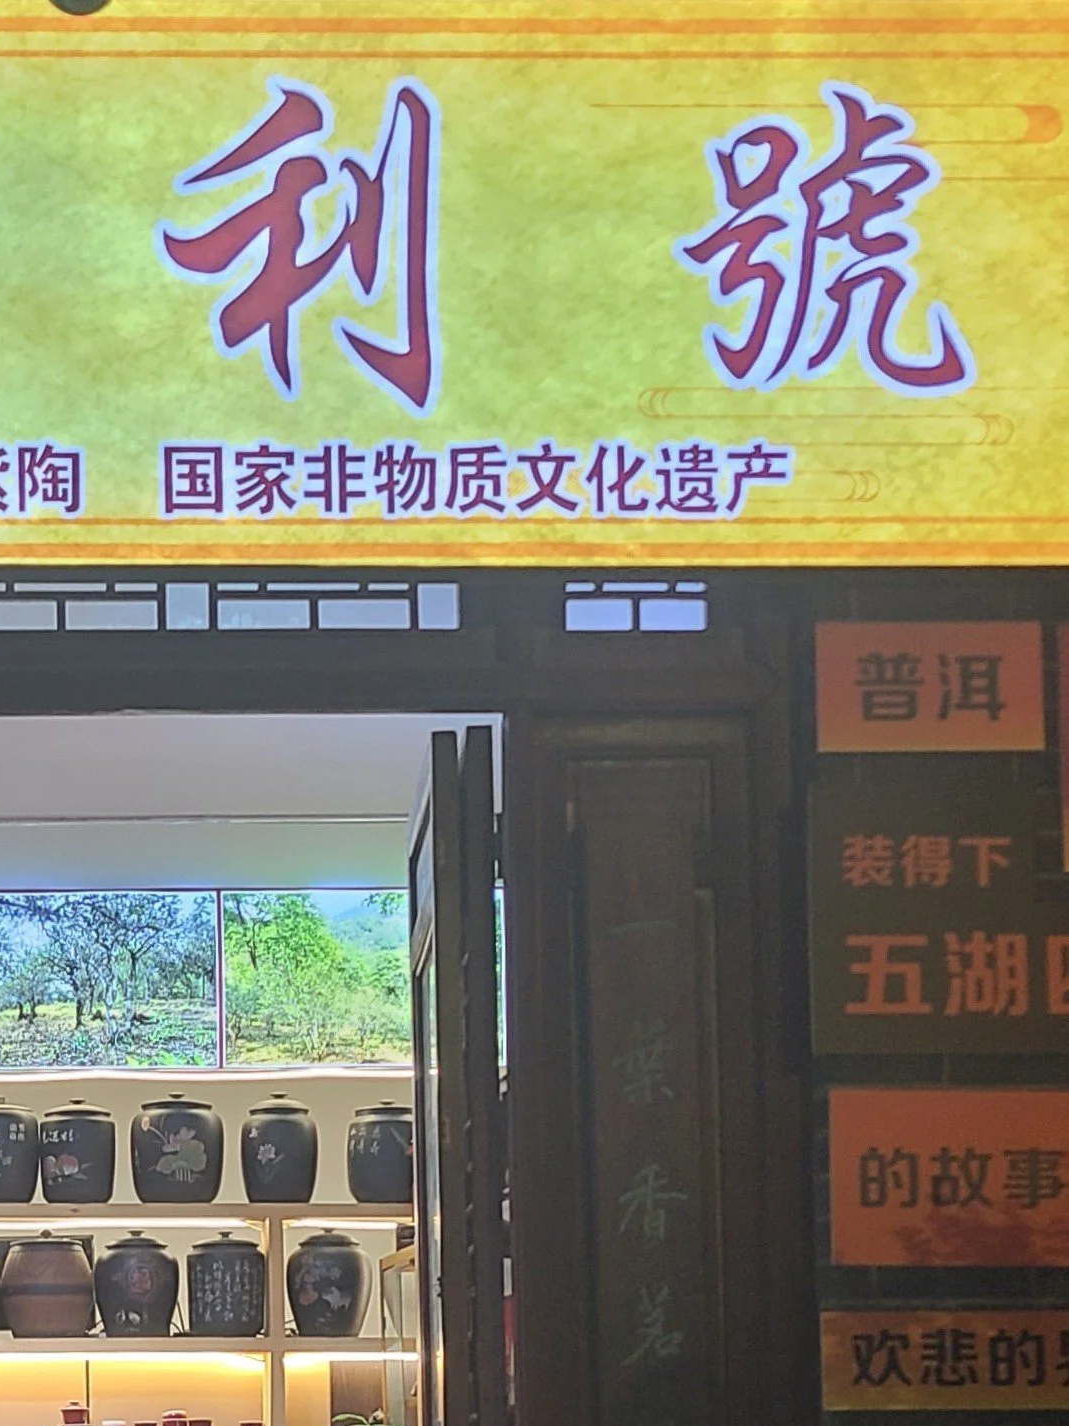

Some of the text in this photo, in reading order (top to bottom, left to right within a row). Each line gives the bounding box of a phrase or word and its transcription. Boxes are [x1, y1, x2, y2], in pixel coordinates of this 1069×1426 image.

[162, 443, 792, 515] 国家非物质文化遗产
[854, 651, 1007, 723] 普洱
[841, 833, 1013, 888] 装得下
[843, 930, 1069, 1018] 五湖
[857, 1146, 1069, 1209] 的故事
[850, 1328, 1069, 1388] 欢悲的
